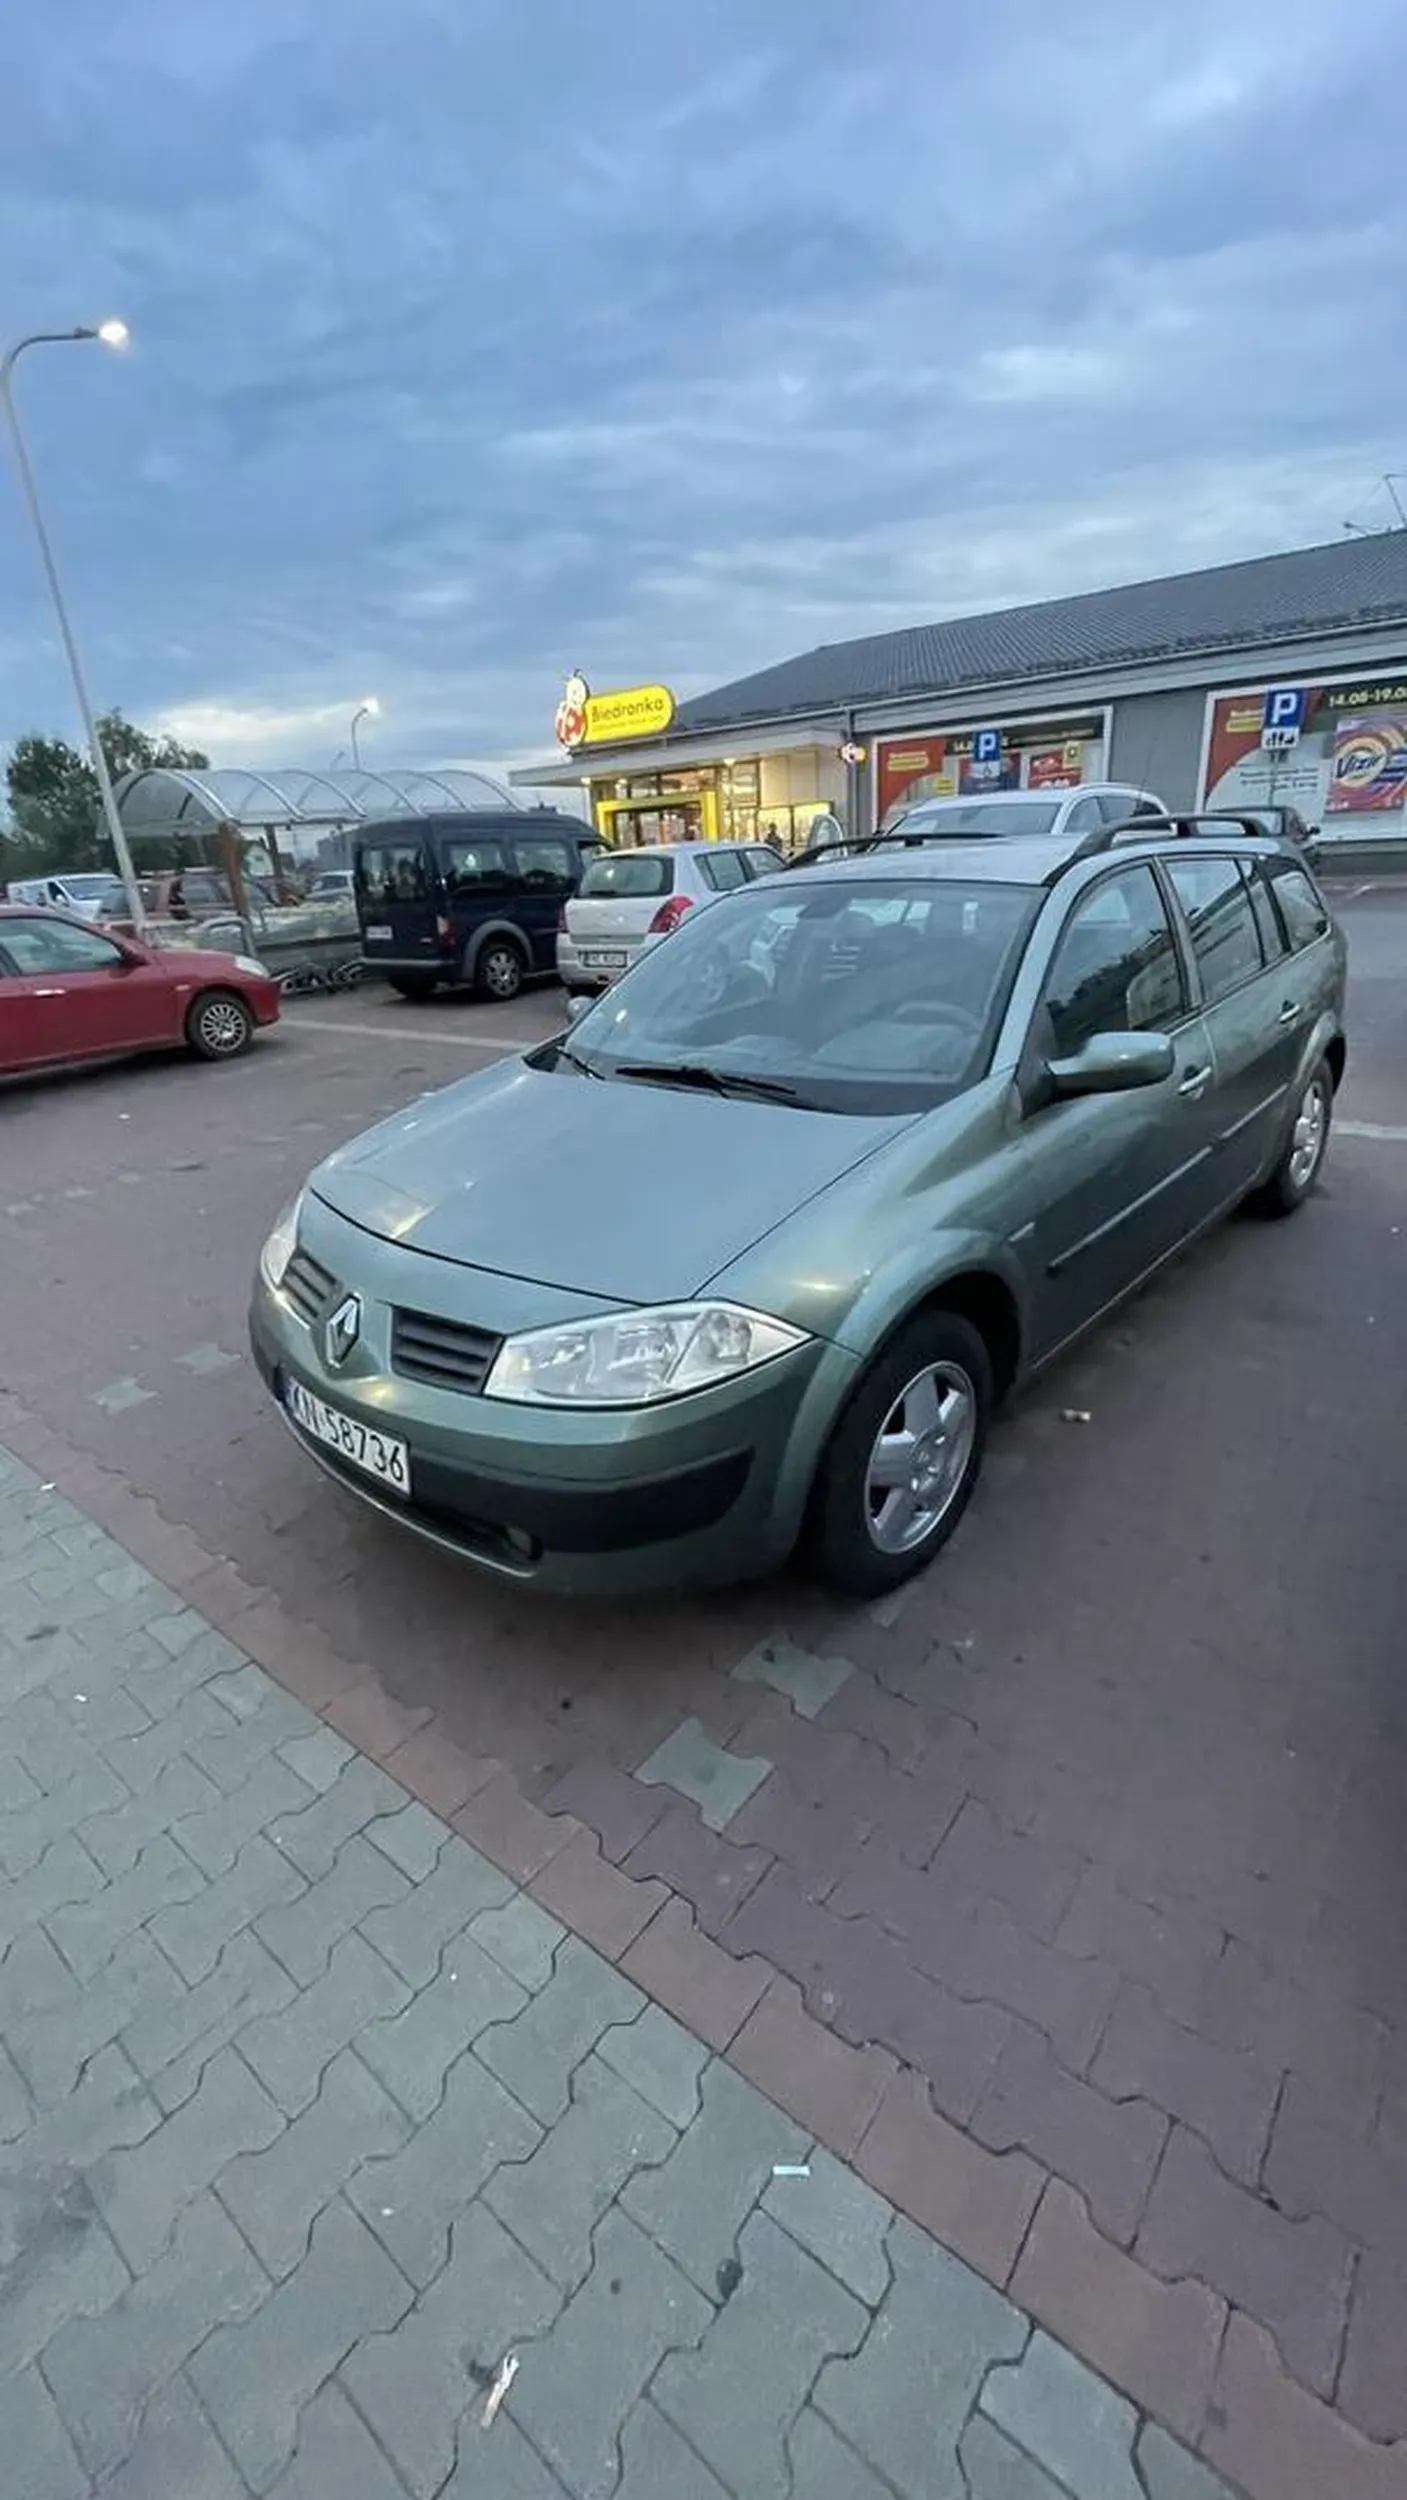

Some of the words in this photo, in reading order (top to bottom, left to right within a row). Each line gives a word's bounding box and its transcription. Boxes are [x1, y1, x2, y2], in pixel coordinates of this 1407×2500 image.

[591, 697, 665, 722] Biedronka
[1271, 692, 1298, 724] P
[979, 732, 997, 760] P
[324, 1407, 404, 1482] 58736
